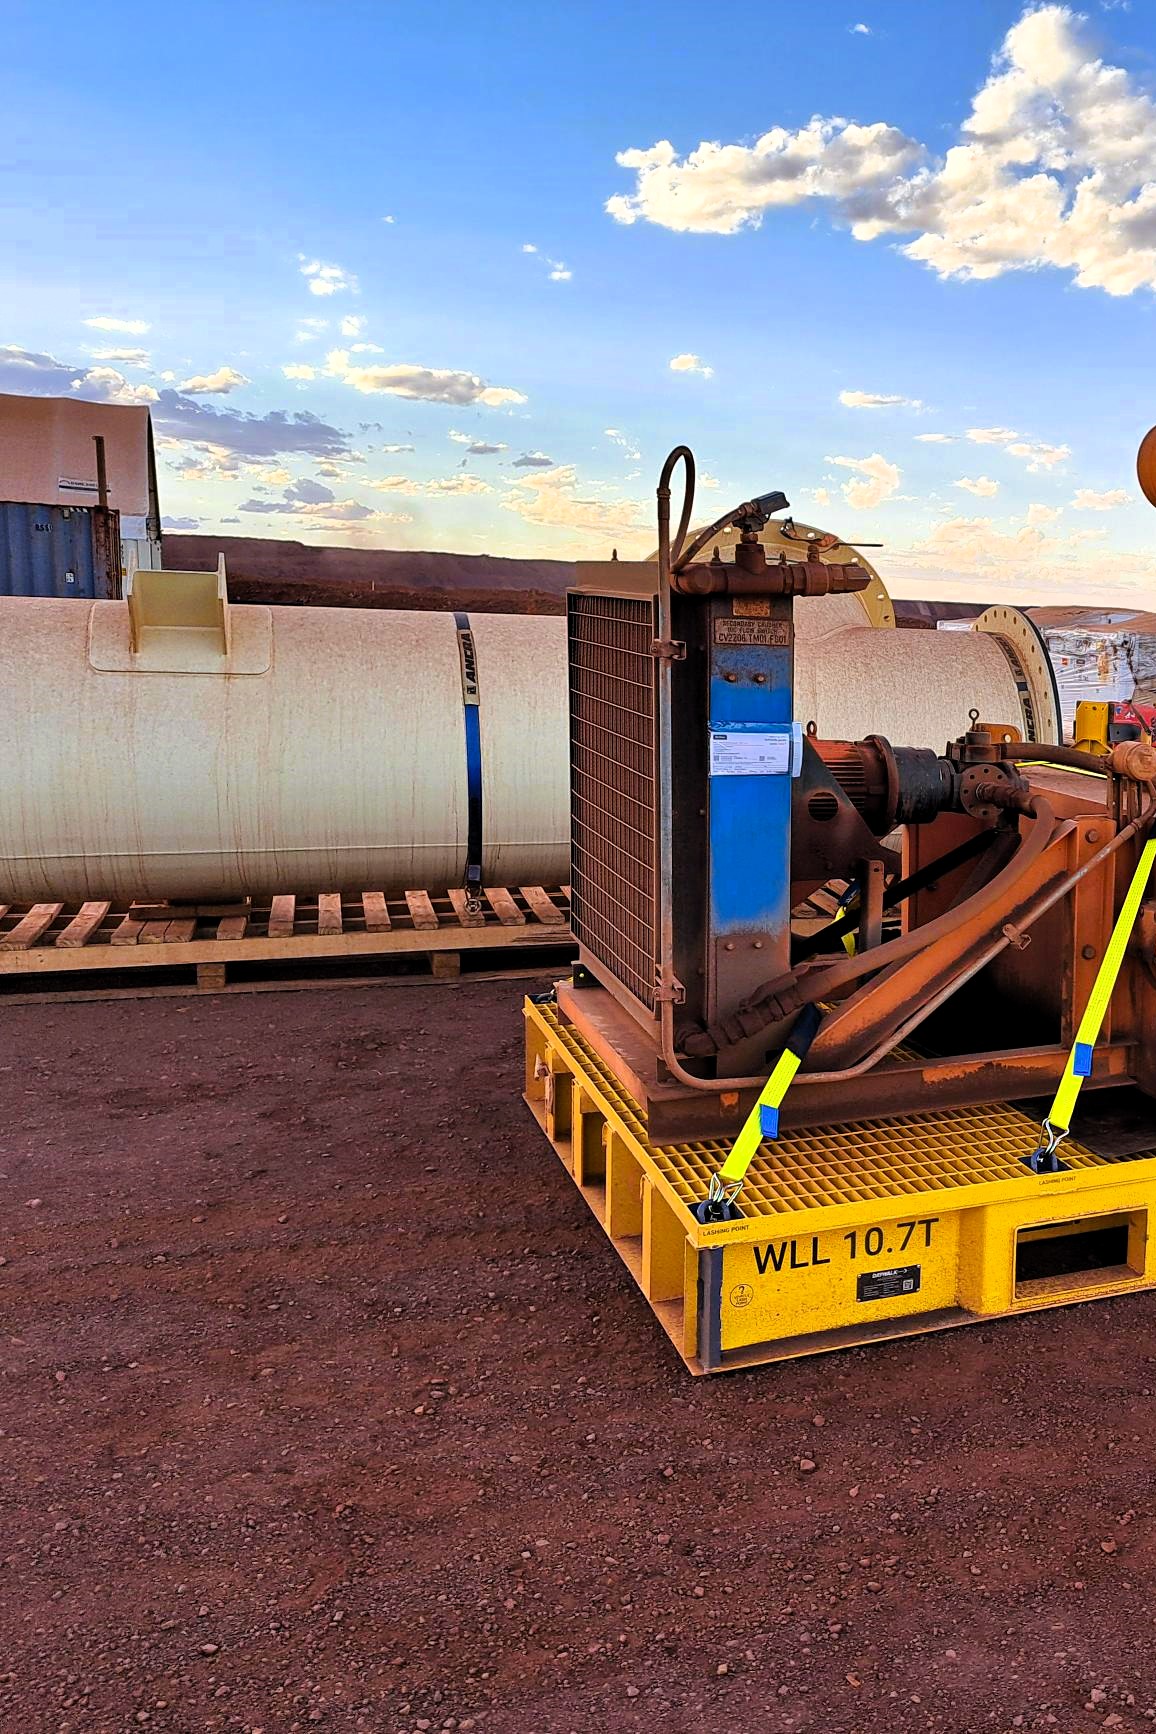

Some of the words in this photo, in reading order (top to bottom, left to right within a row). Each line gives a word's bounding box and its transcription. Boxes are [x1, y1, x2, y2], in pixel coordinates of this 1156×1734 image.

[461, 633, 476, 683] ANCRA
[702, 1227, 730, 1237] LASHING
[730, 1224, 750, 1232] POINT
[753, 1236, 831, 1275] WLL
[843, 1217, 940, 1260] 10.7T
